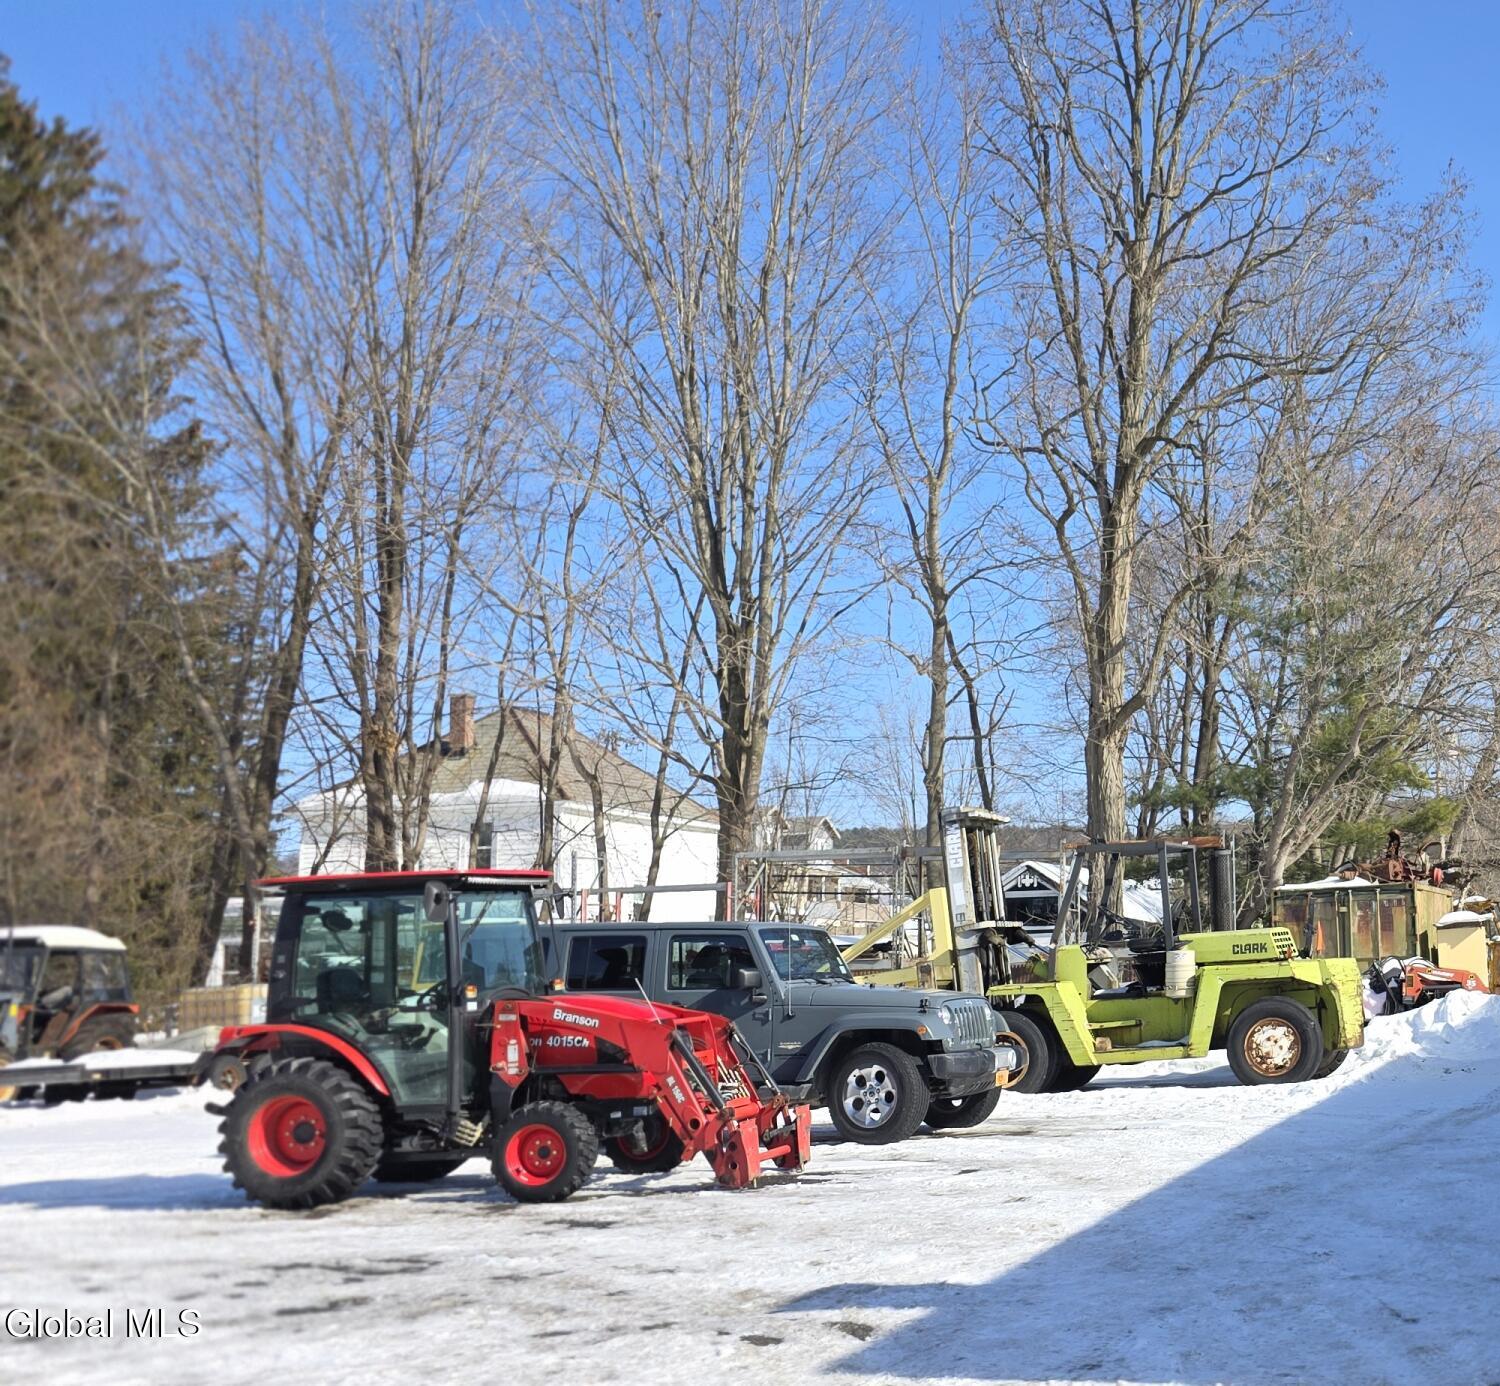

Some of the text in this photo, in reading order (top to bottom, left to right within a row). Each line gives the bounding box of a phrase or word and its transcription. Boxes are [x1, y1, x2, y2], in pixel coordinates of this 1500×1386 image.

[945, 822, 964, 868] CLARK
[1232, 942, 1269, 955] CLARK
[553, 1008, 599, 1028] Branson
